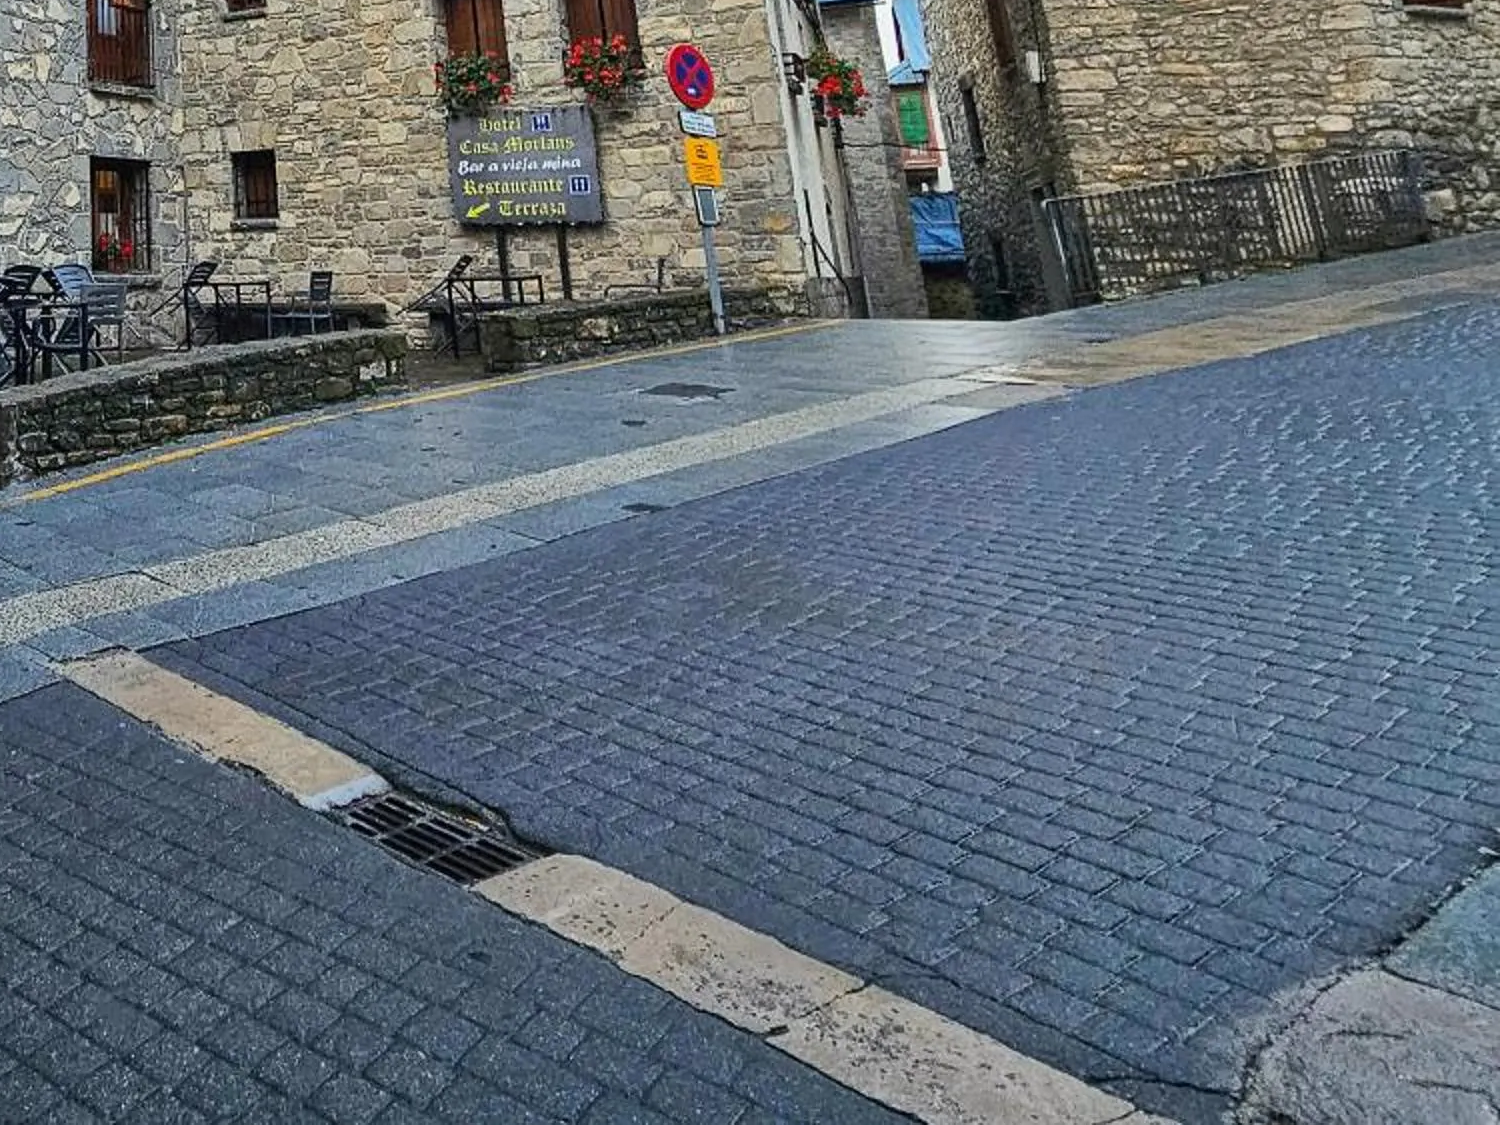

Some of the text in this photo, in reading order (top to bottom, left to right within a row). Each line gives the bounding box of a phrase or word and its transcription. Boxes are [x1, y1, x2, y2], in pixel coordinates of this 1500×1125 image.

[479, 116, 522, 134] Hotel
[459, 135, 576, 155] Casa Morlans
[458, 154, 581, 175] Bar a vieja mina
[462, 178, 564, 196] Restaurante
[498, 200, 567, 217] Terraza
